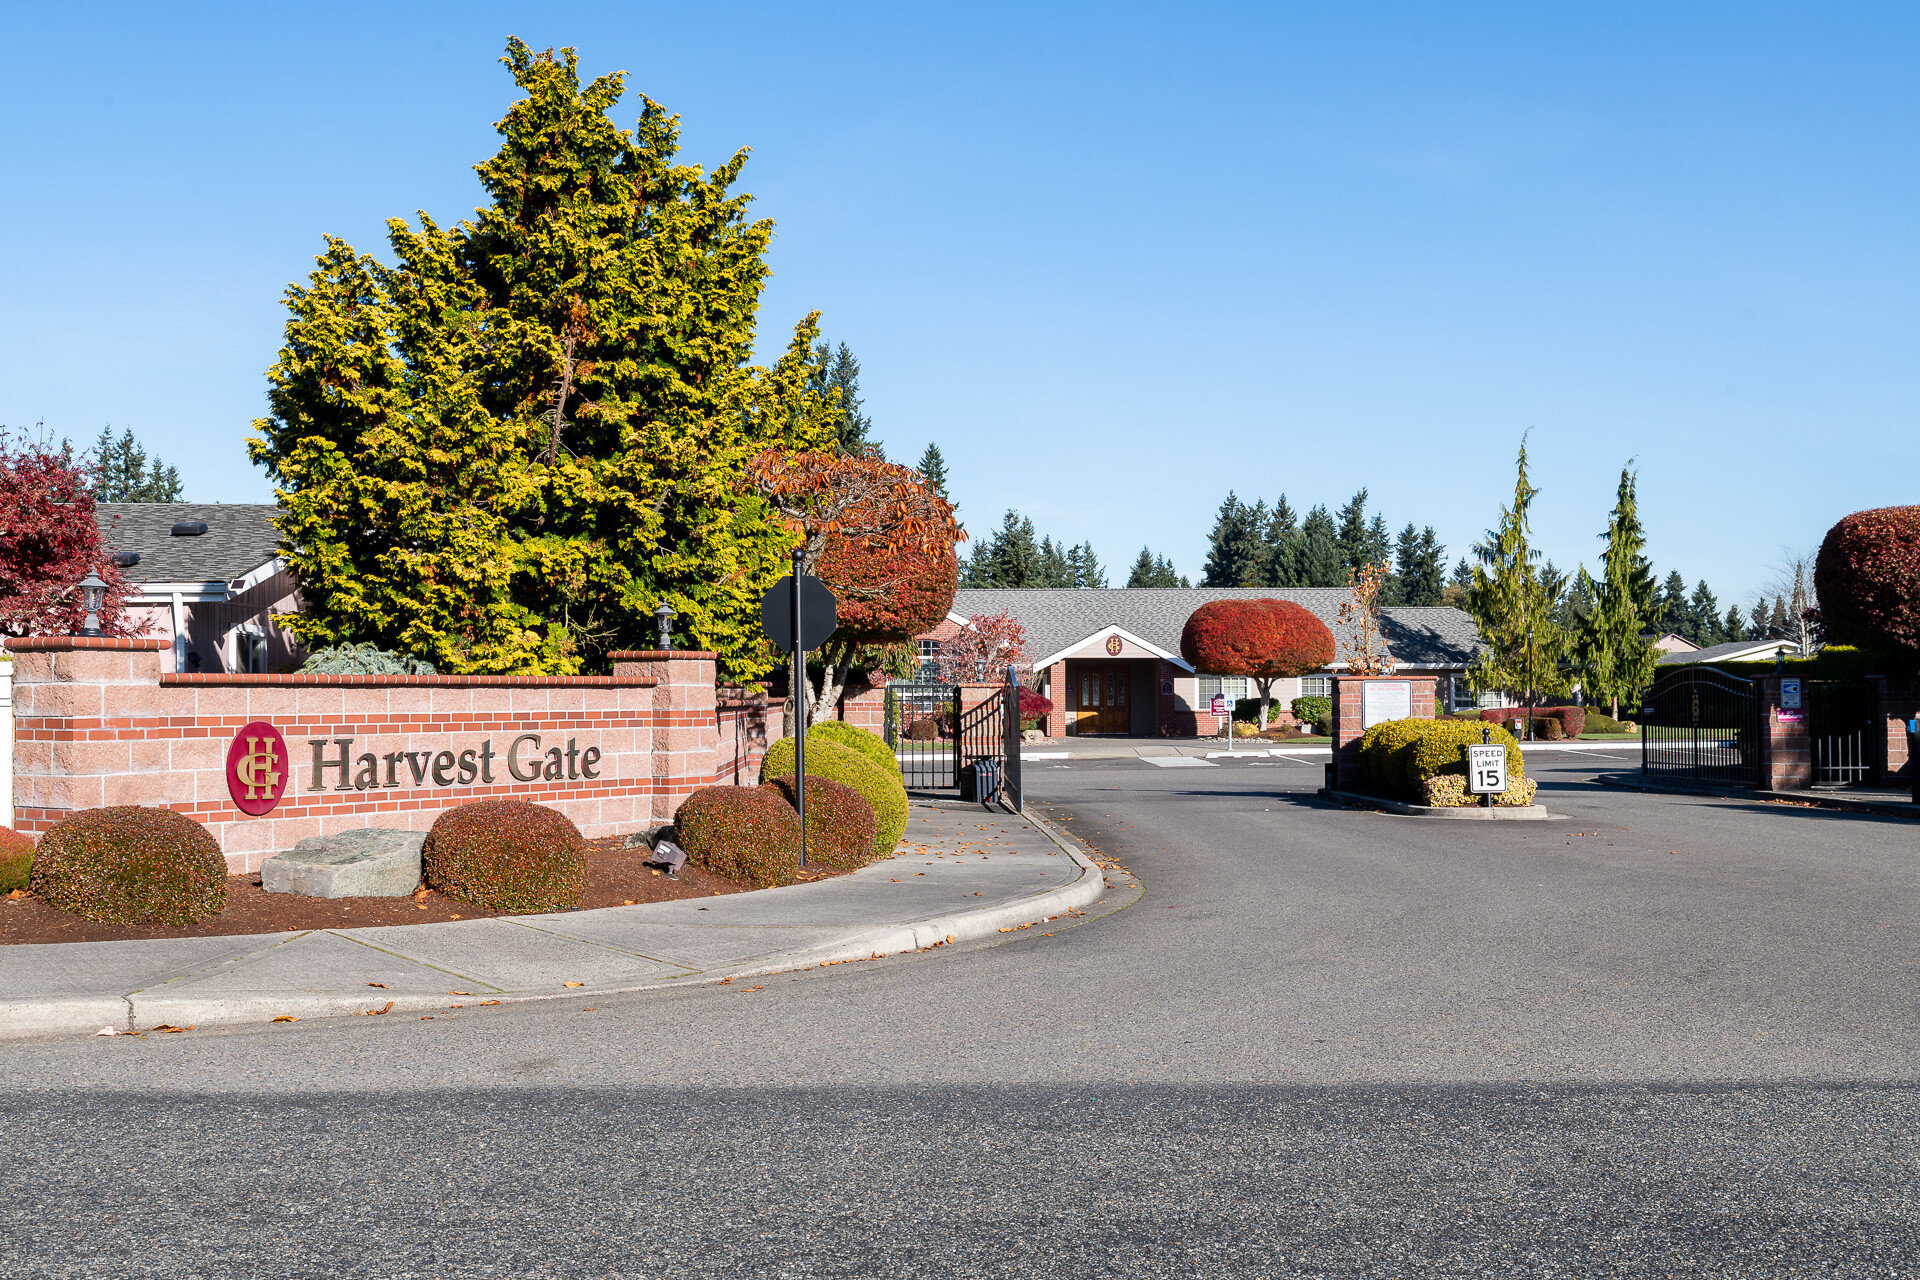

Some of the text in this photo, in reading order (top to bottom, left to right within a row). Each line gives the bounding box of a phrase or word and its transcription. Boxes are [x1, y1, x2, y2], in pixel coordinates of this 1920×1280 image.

[307, 733, 602, 791] Harvest Gate
[1477, 770, 1500, 787] 15
